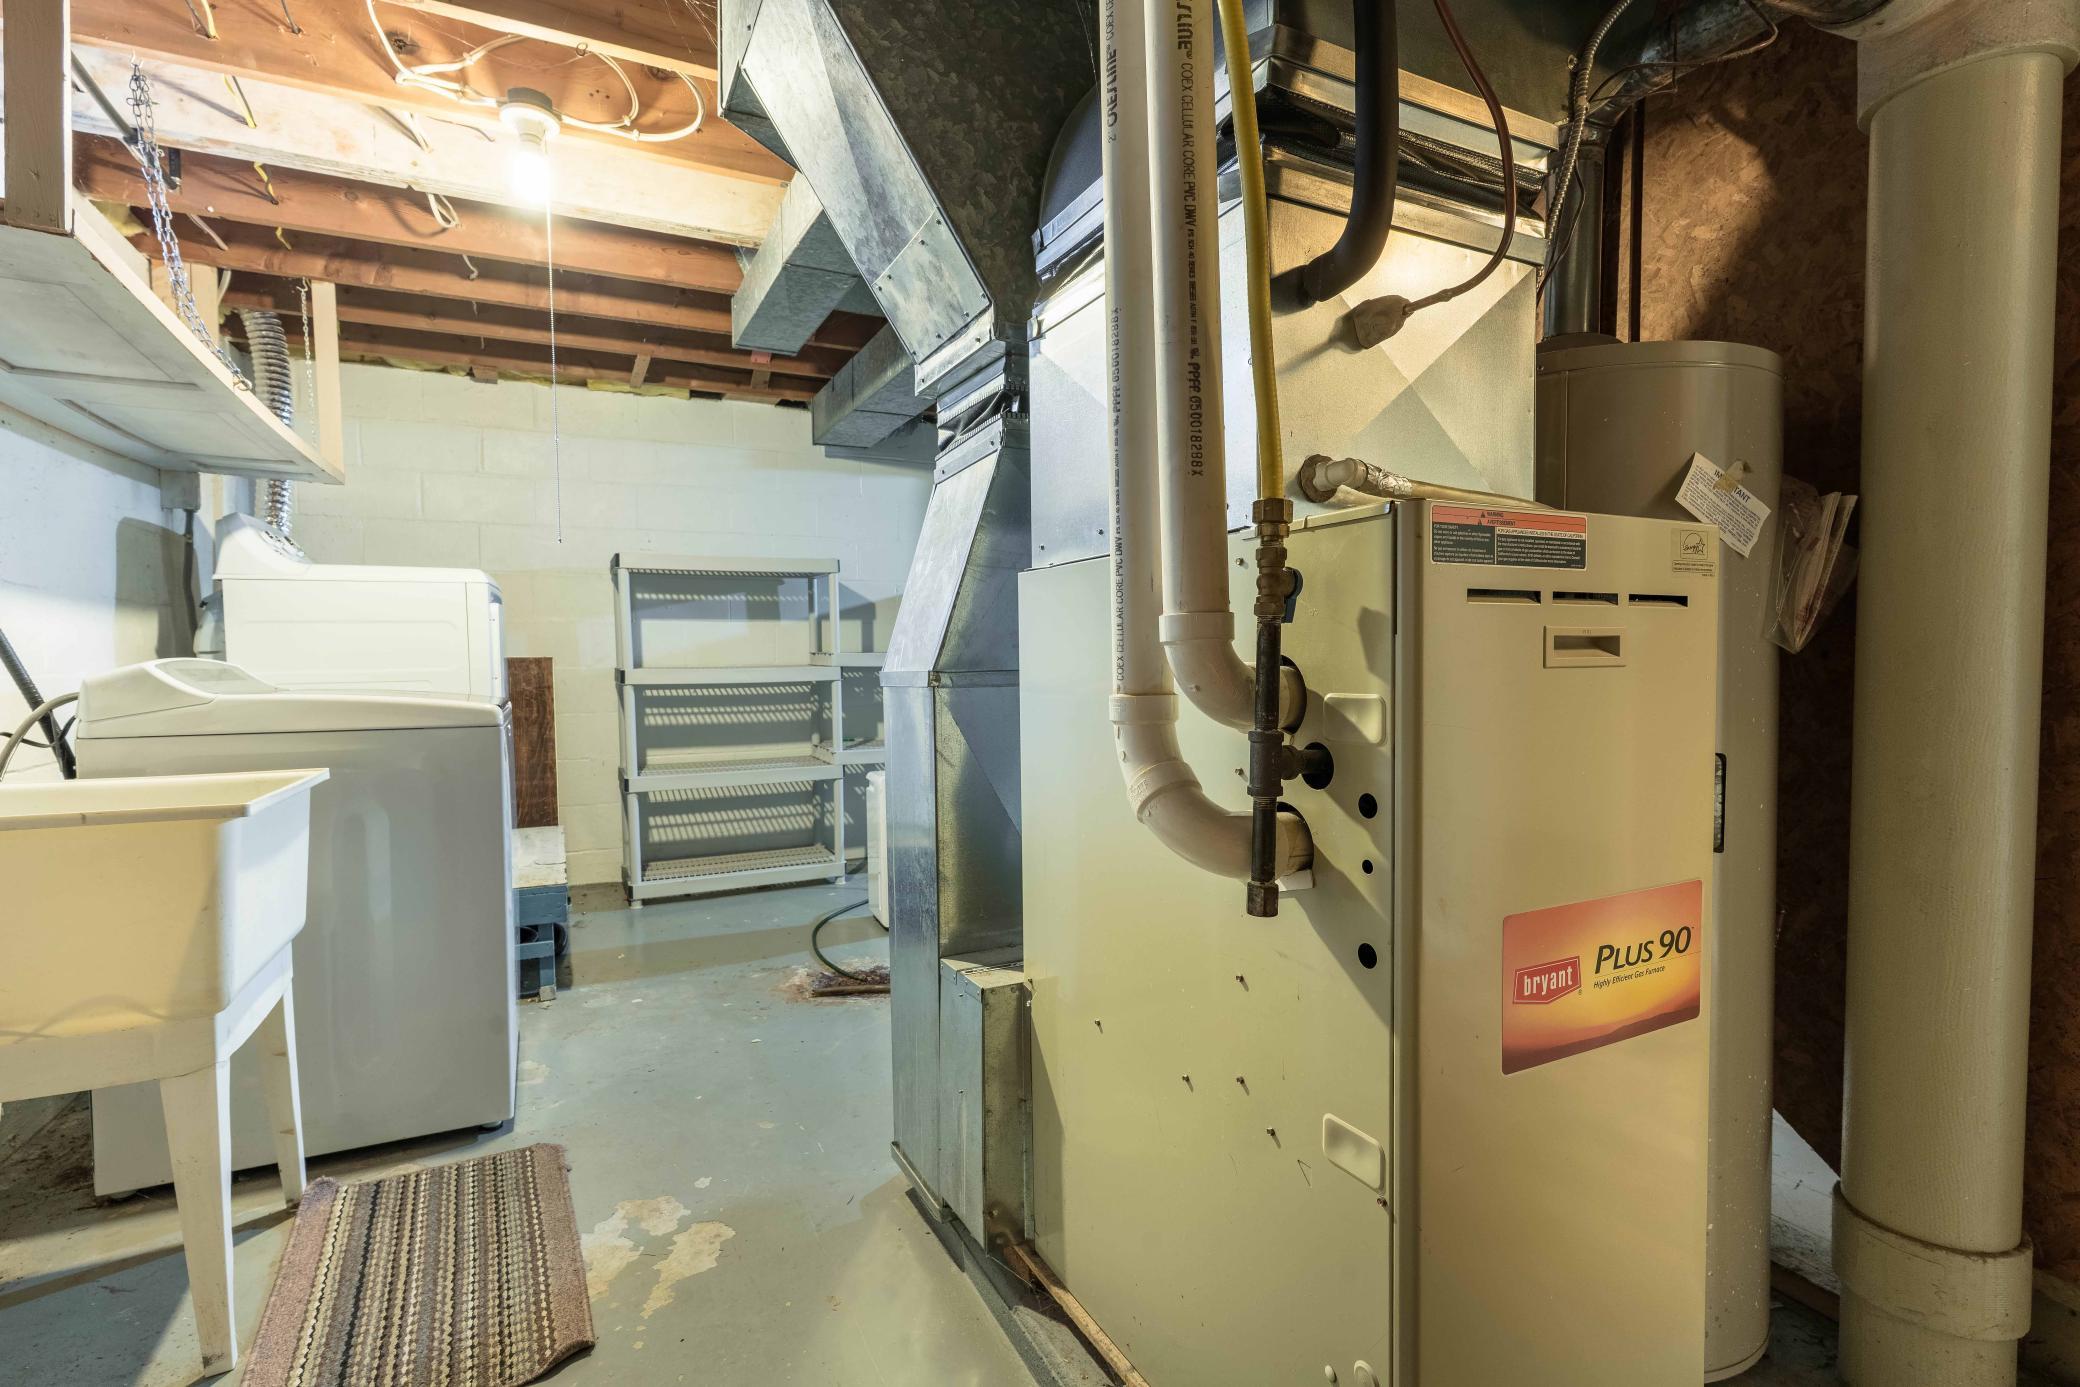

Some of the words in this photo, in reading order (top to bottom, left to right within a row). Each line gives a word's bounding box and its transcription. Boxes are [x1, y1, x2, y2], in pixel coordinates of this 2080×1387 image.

[1105, 11, 1115, 40] COEX
[1180, 62, 1194, 92] COEX
[1181, 95, 1194, 148] CELLULAR
[1182, 150, 1196, 179] CORE
[1183, 181, 1196, 202] PVC
[1184, 204, 1197, 227] DWV
[1114, 536, 1124, 556] DWV
[1115, 558, 1124, 577] PVC
[1115, 578, 1124, 604] CORE
[1116, 606, 1125, 653] CELLULAR
[1116, 656, 1125, 681] COEX
[1594, 940, 1654, 975] PLUS
[1659, 925, 1692, 958] 90
[1523, 965, 1573, 997] bryant
[1593, 979, 1611, 989] Highly
[1612, 973, 1633, 985] Efficient
[1634, 970, 1644, 979] Gas
[1645, 965, 1665, 976] Furnace
